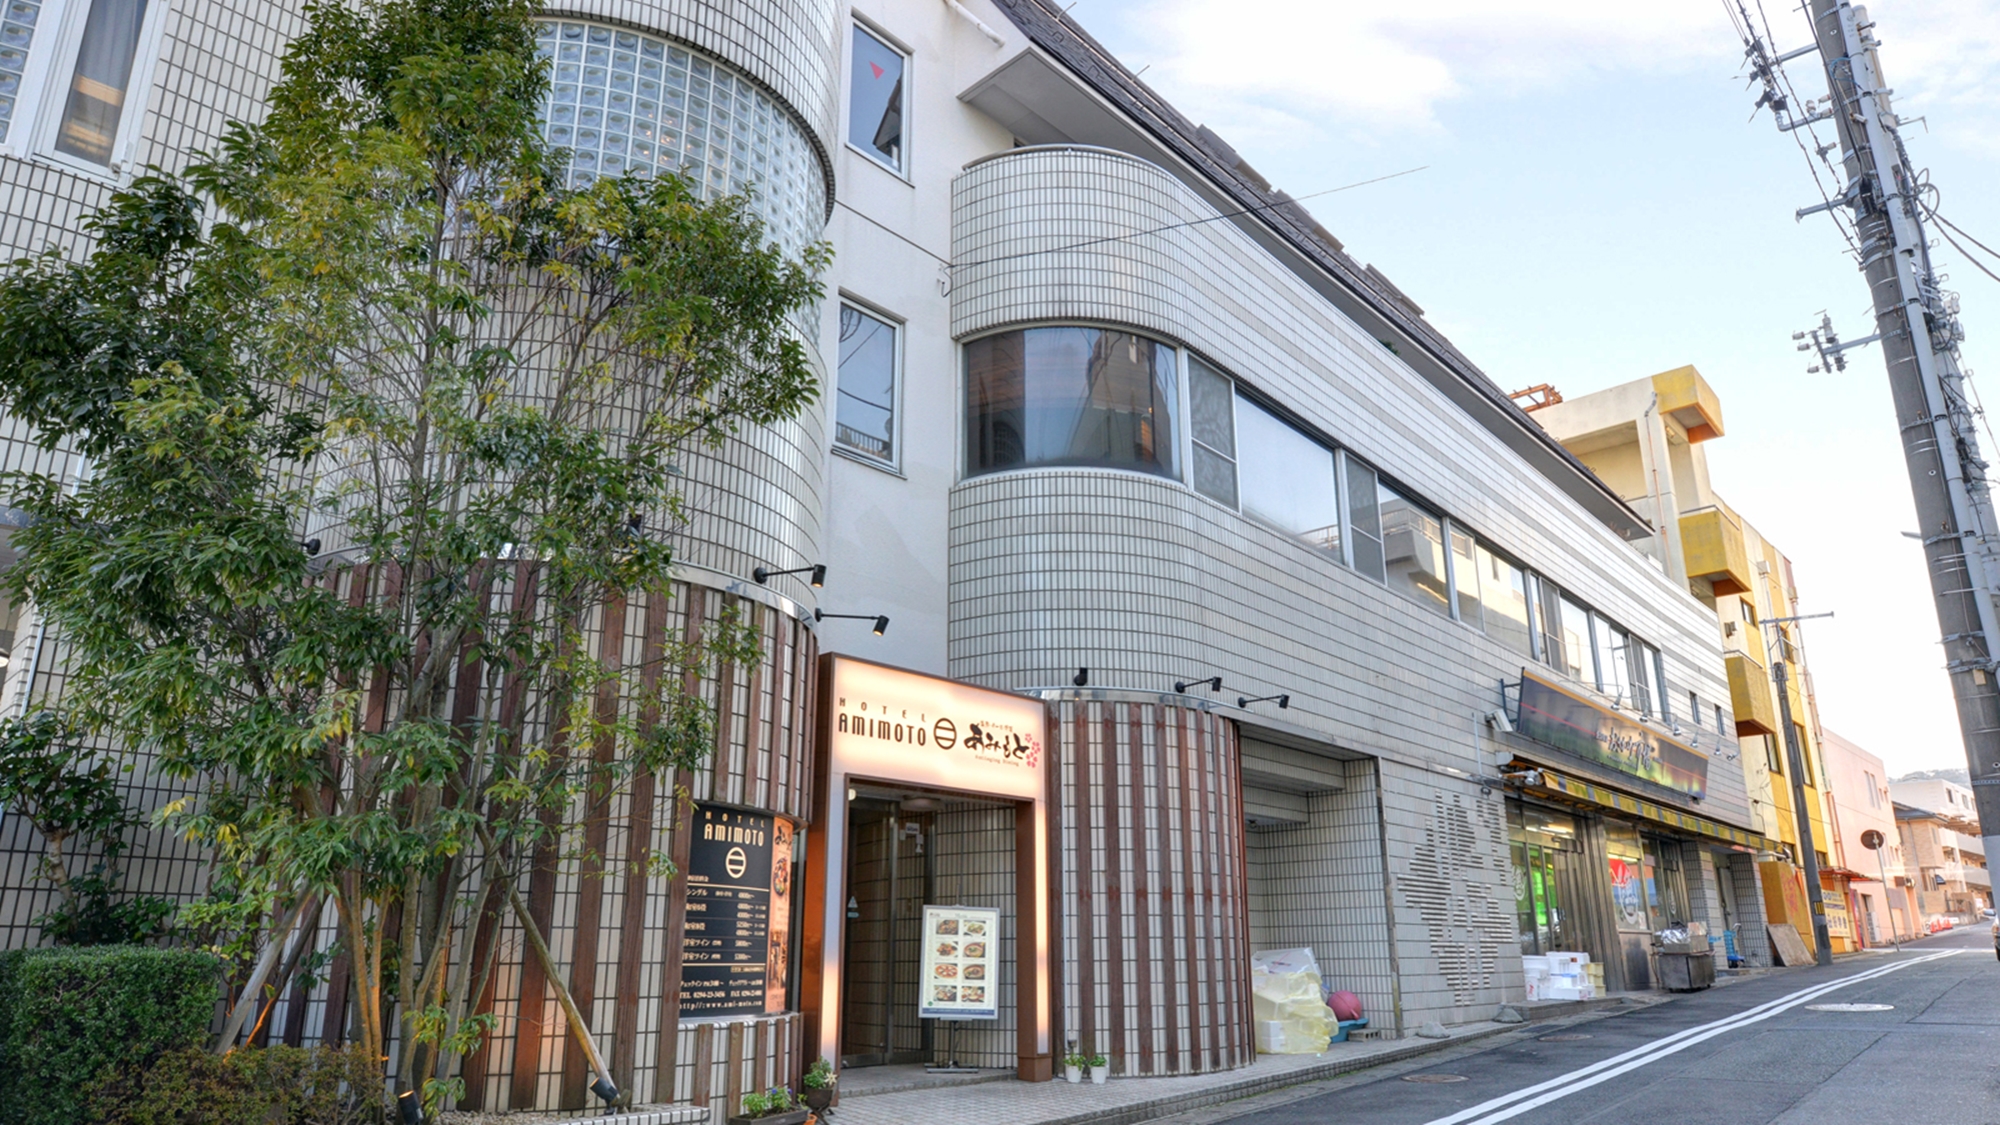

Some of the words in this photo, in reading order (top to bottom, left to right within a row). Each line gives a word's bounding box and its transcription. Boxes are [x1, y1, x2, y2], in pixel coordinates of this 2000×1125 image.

[839, 697, 926, 723] HOTEL
[838, 712, 926, 747] AMIMOTO
[963, 723, 1030, 760] あみもと
[705, 810, 765, 828] HOTEL
[704, 823, 765, 847] AMIMOTO
